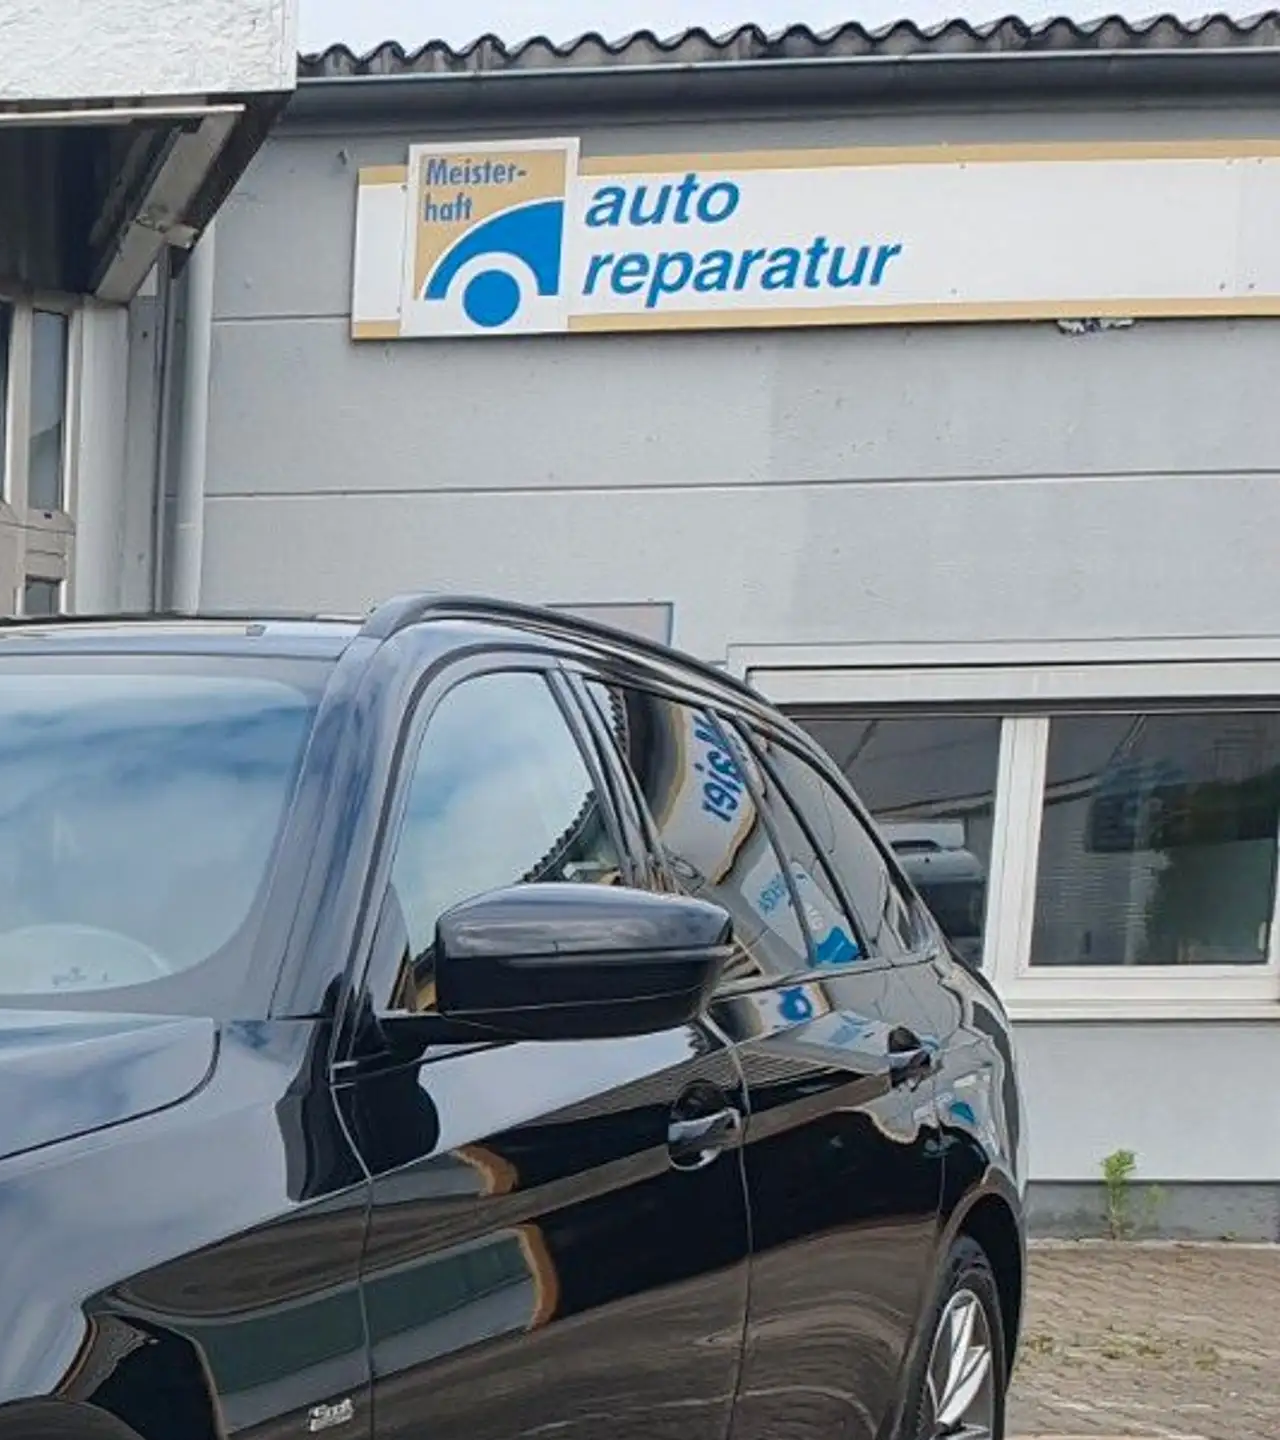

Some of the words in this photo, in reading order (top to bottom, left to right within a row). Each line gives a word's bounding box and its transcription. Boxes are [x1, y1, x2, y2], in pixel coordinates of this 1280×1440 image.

[426, 157, 527, 185] Meister-
[425, 192, 473, 222] haft
[584, 172, 740, 227] auto
[582, 236, 903, 309] reparatur
